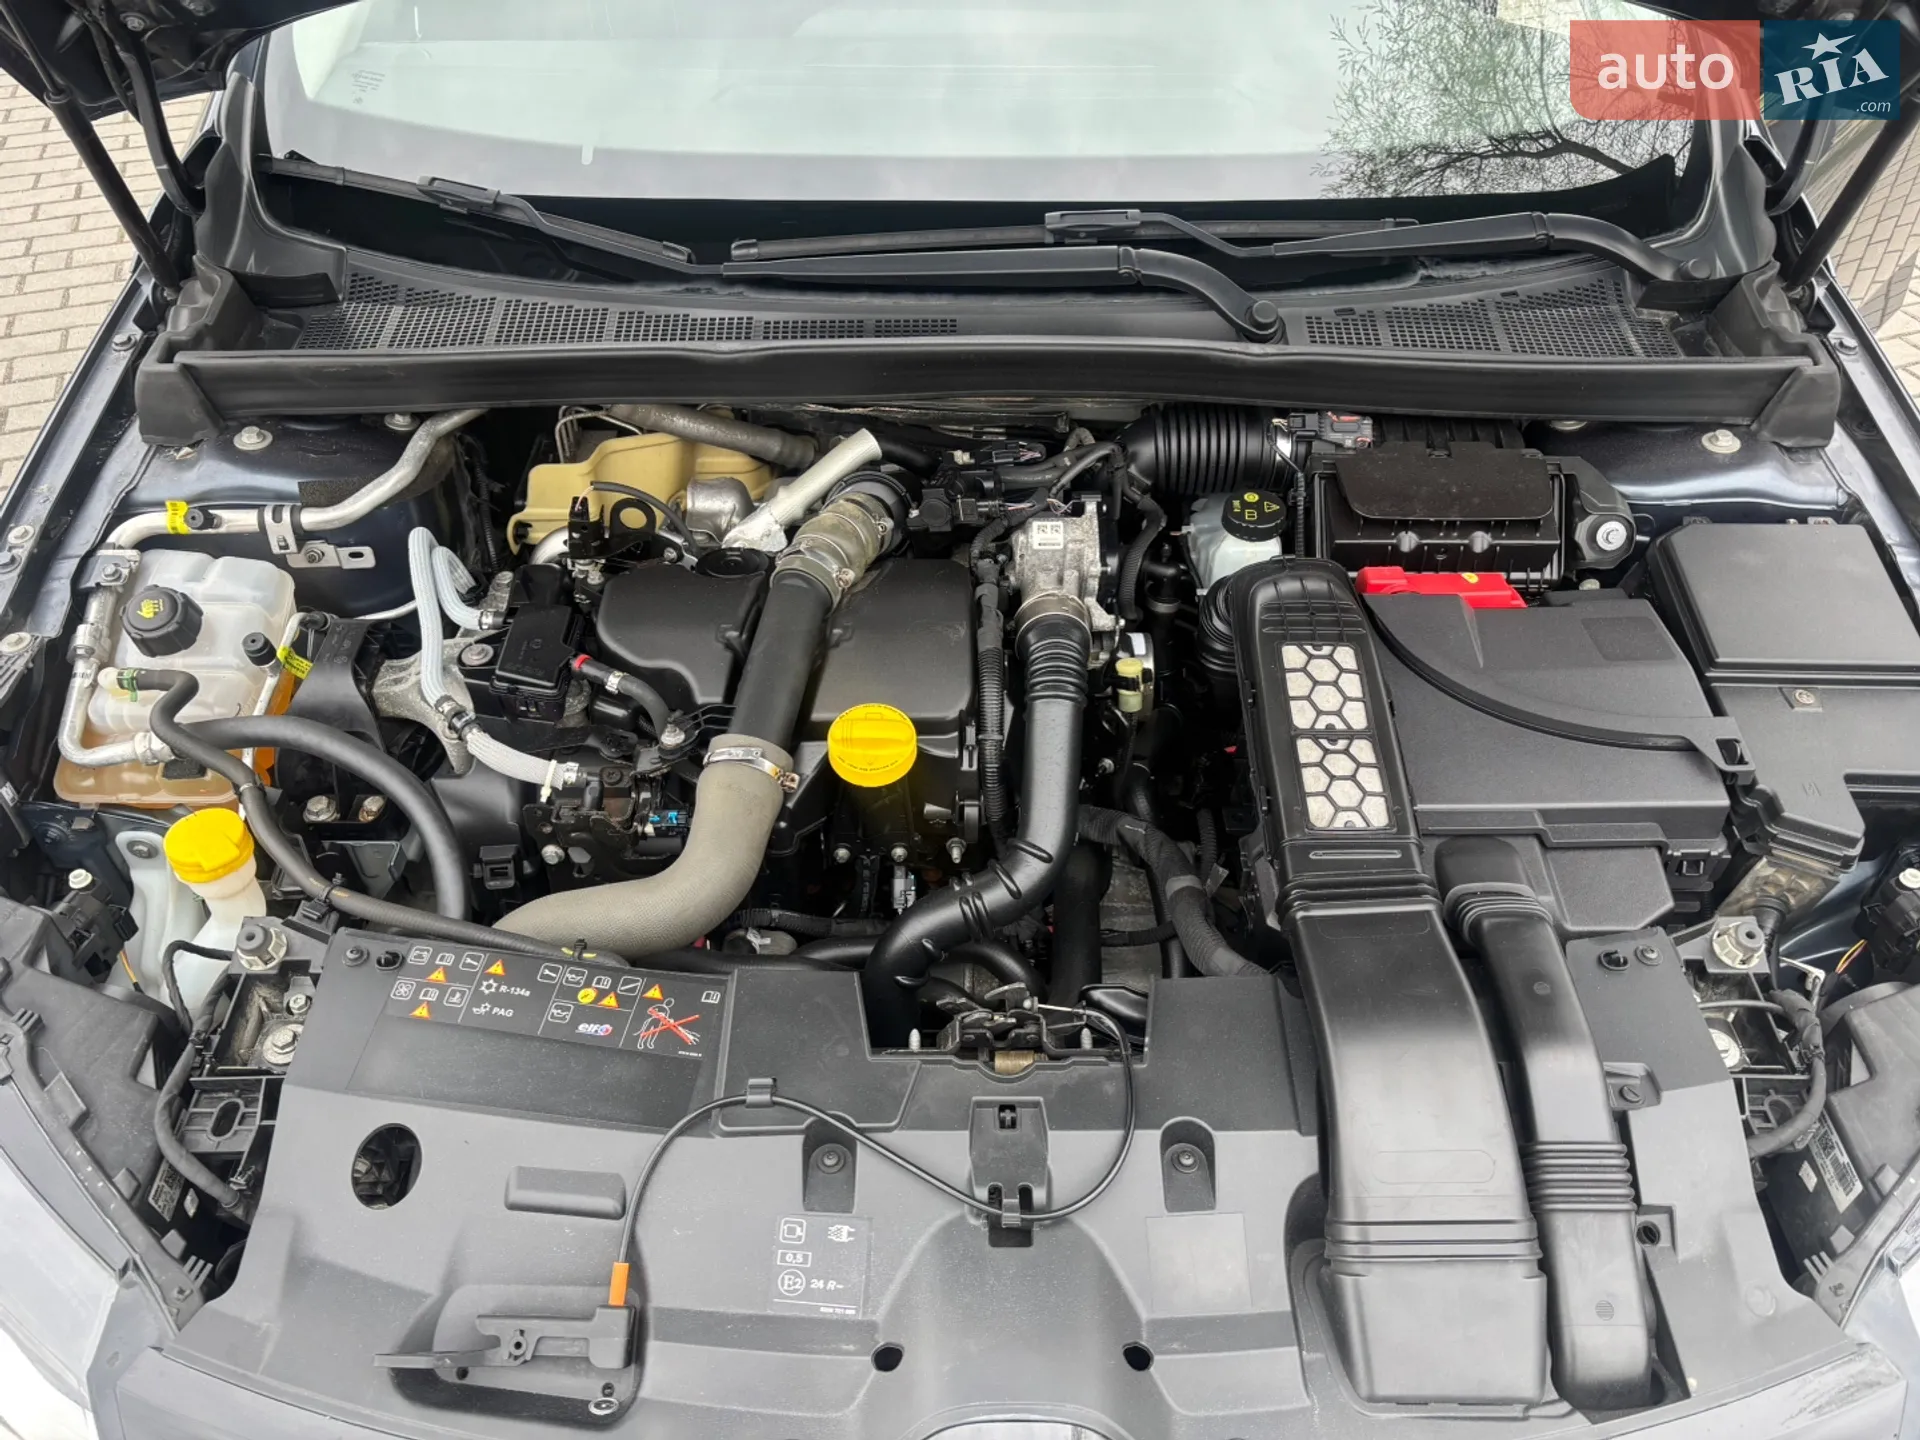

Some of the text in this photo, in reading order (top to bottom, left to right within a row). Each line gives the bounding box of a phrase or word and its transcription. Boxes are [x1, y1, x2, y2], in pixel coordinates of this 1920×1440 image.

[499, 984, 531, 997] R-134a
[491, 1006, 514, 1017] PAG
[577, 1023, 601, 1036] elf
[783, 1275, 802, 1290] E2
